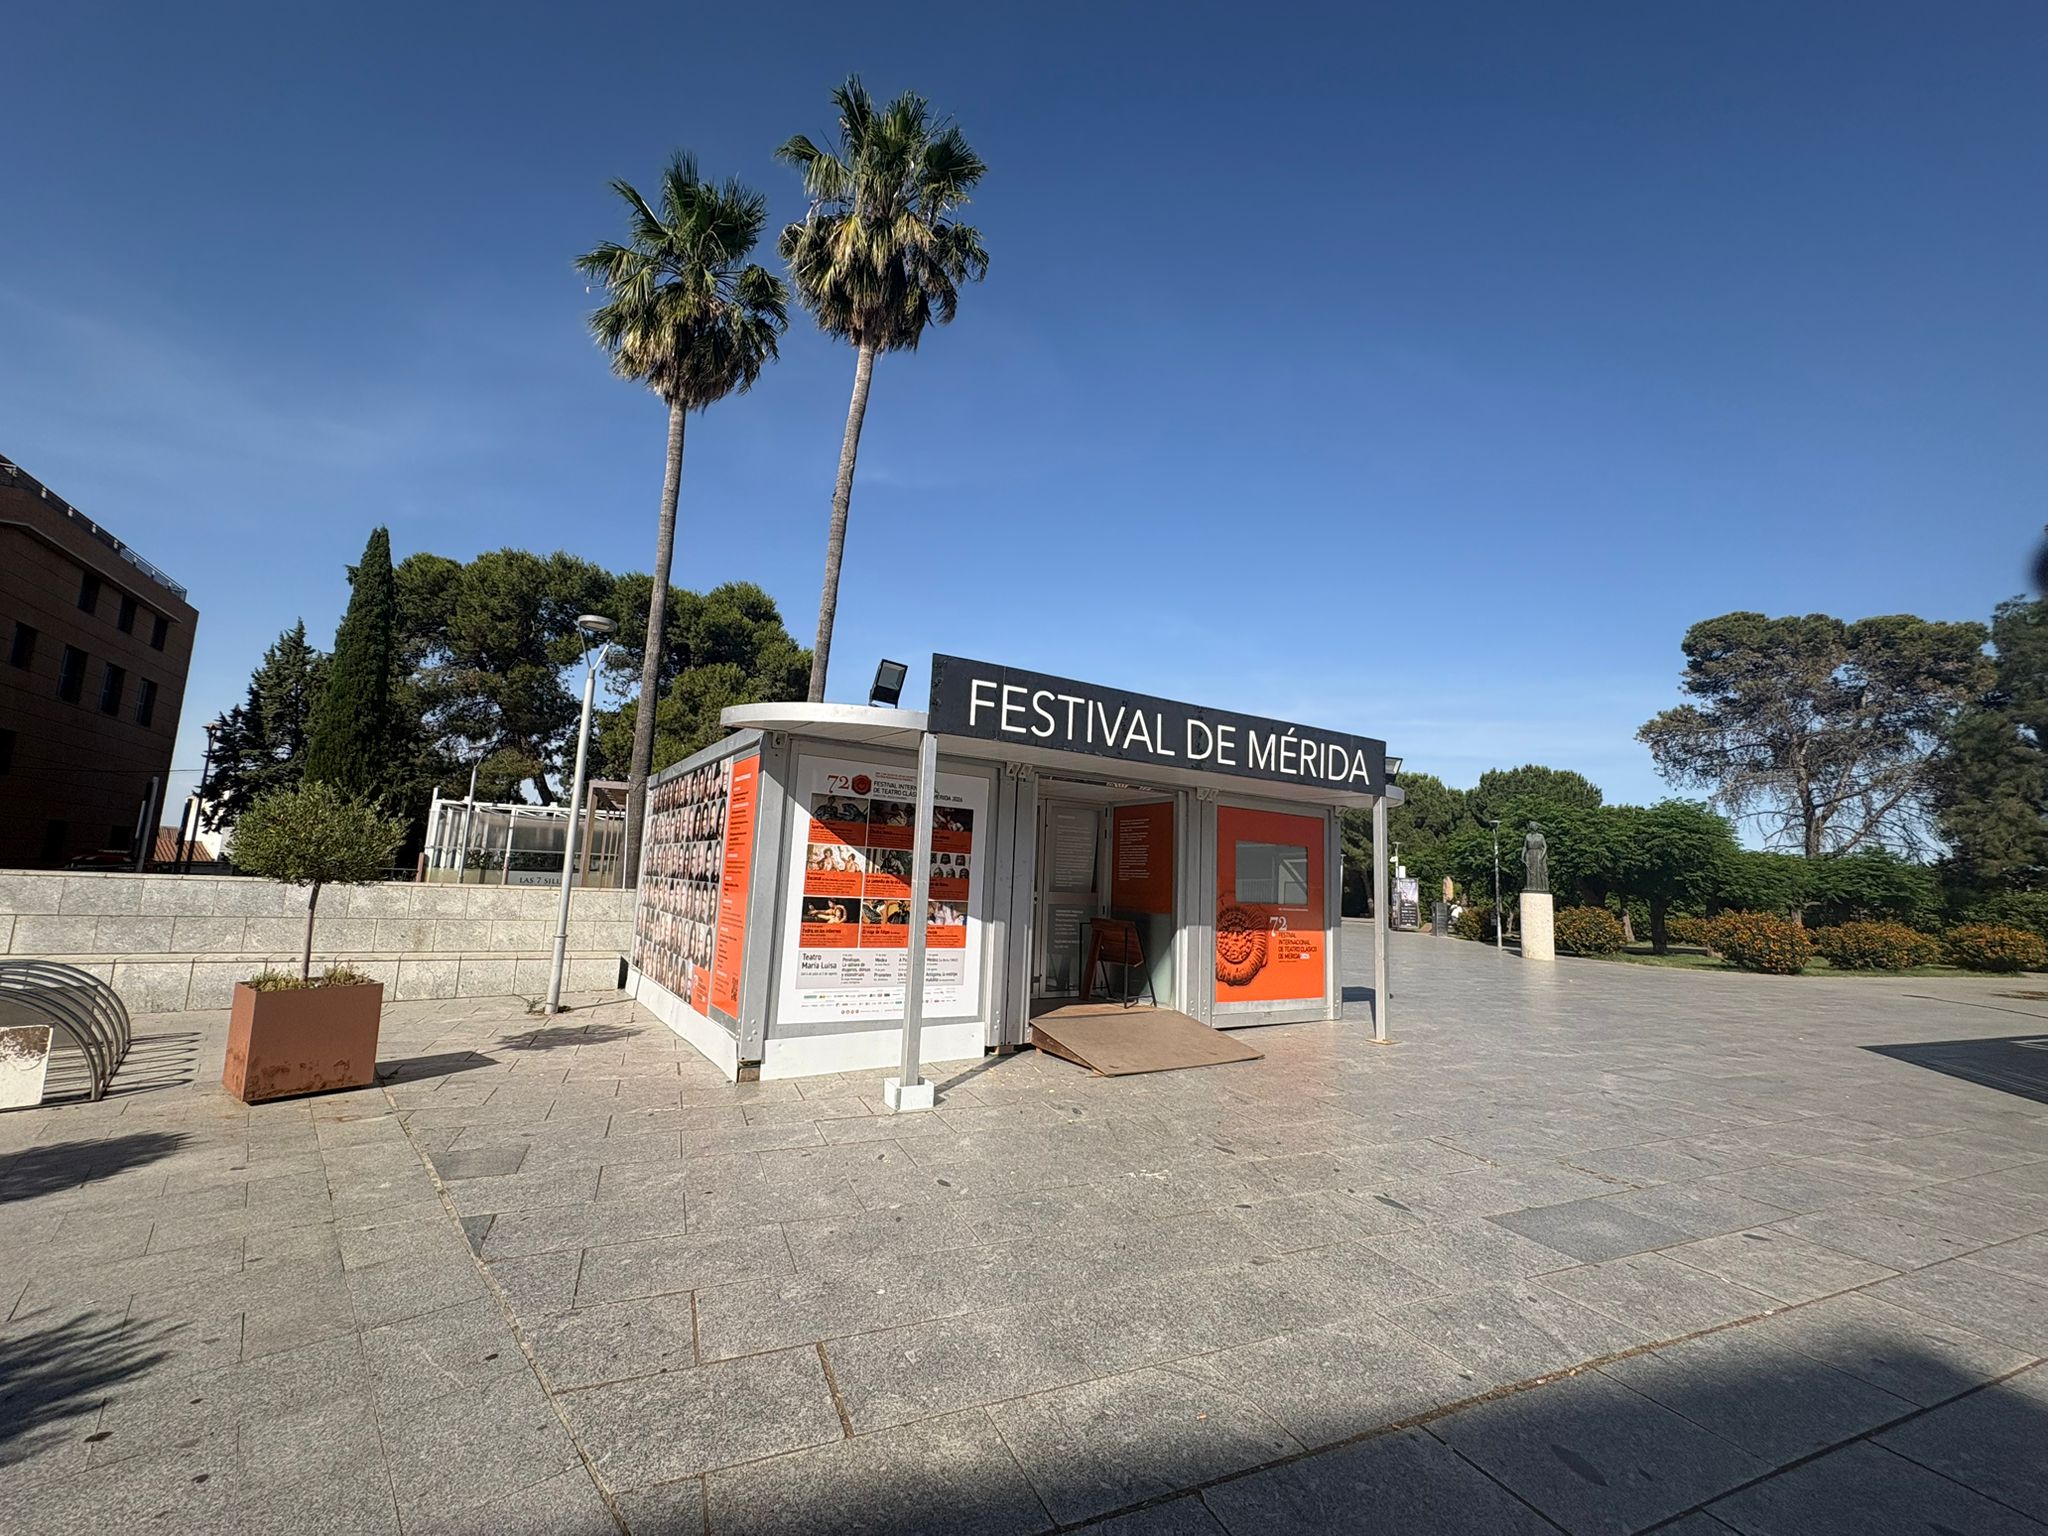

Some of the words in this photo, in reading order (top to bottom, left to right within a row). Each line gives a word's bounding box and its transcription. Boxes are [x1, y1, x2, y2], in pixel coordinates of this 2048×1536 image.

[968, 678, 1176, 756] FESTIVAL
[1186, 718, 1237, 766] DE
[1248, 727, 1371, 786] MÉRIDA
[827, 775, 849, 794] 72
[873, 781, 897, 789] FESTIVAL
[882, 788, 901, 796] TEATRO
[536, 876, 541, 884] 7
[1270, 916, 1288, 937] 72
[802, 961, 819, 969] María
[821, 961, 837, 969] Luisa
